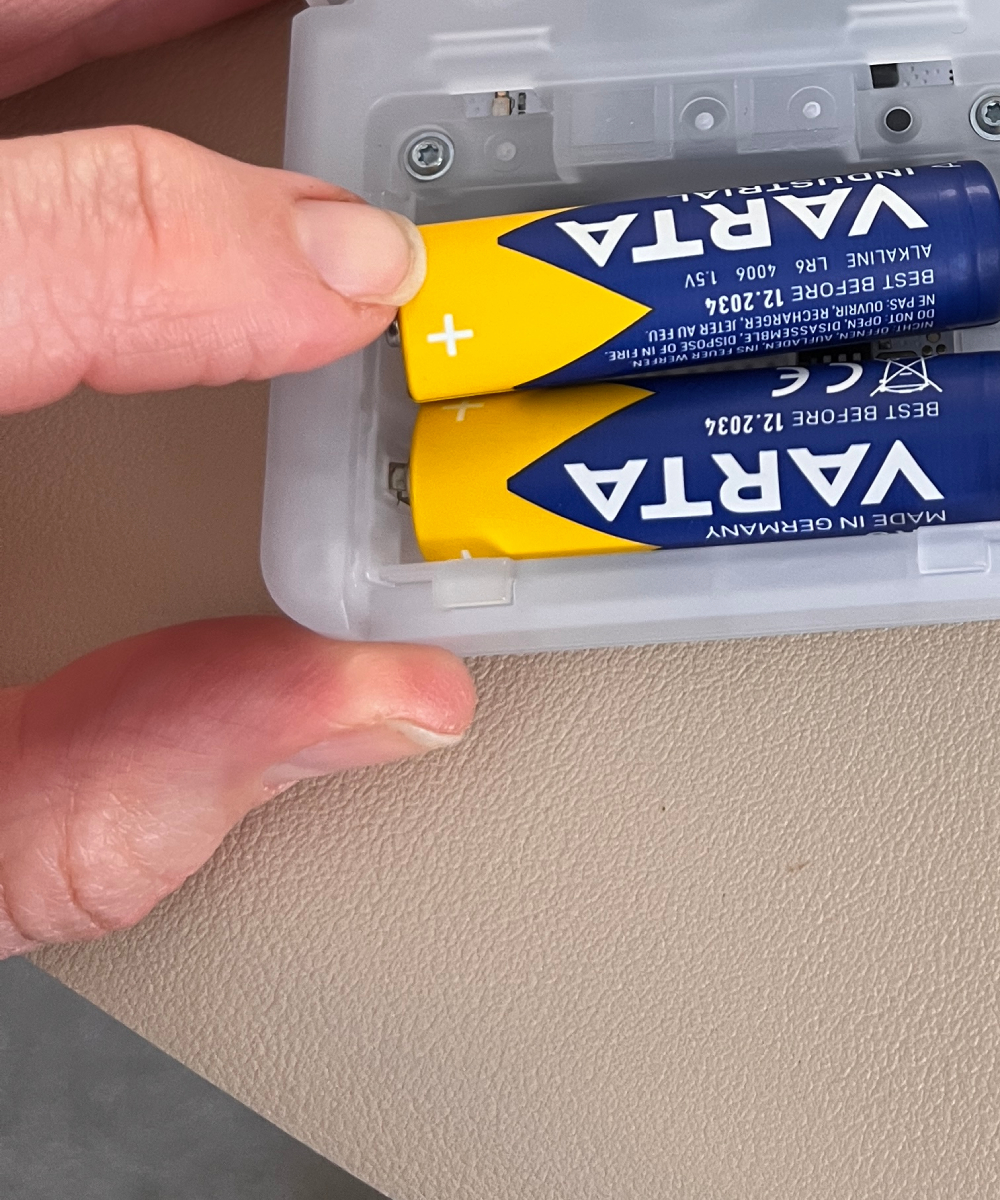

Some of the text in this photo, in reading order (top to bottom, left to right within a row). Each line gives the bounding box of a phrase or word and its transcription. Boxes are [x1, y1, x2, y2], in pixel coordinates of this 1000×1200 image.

[667, 168, 914, 202] INDUSTRIAL
[555, 183, 929, 268] VARTA
[684, 244, 932, 288] ALKALINE LR6 4006 1.5V
[704, 269, 934, 316] BEST BEFORE 12.2034
[918, 294, 935, 306] NE
[832, 300, 883, 318] OUVRIR,
[886, 296, 914, 310] PAS:
[740, 308, 829, 330] RECHARGER,
[844, 316, 882, 329] OPEN,
[918, 308, 935, 320] DO
[678, 325, 696, 338] AU
[700, 320, 736, 334] JETER
[739, 320, 841, 343] DISASSEMBLE,
[642, 346, 655, 356] IN
[660, 344, 676, 353] OF
[681, 334, 736, 351] DISPOSE
[736, 344, 758, 353] INS
[604, 349, 637, 361] FIRE.
[771, 362, 863, 397] CE
[704, 401, 939, 436] BEST BEFORE 12.2034
[564, 440, 944, 522] VARTA
[705, 510, 946, 538] MADE IN GERMANY
